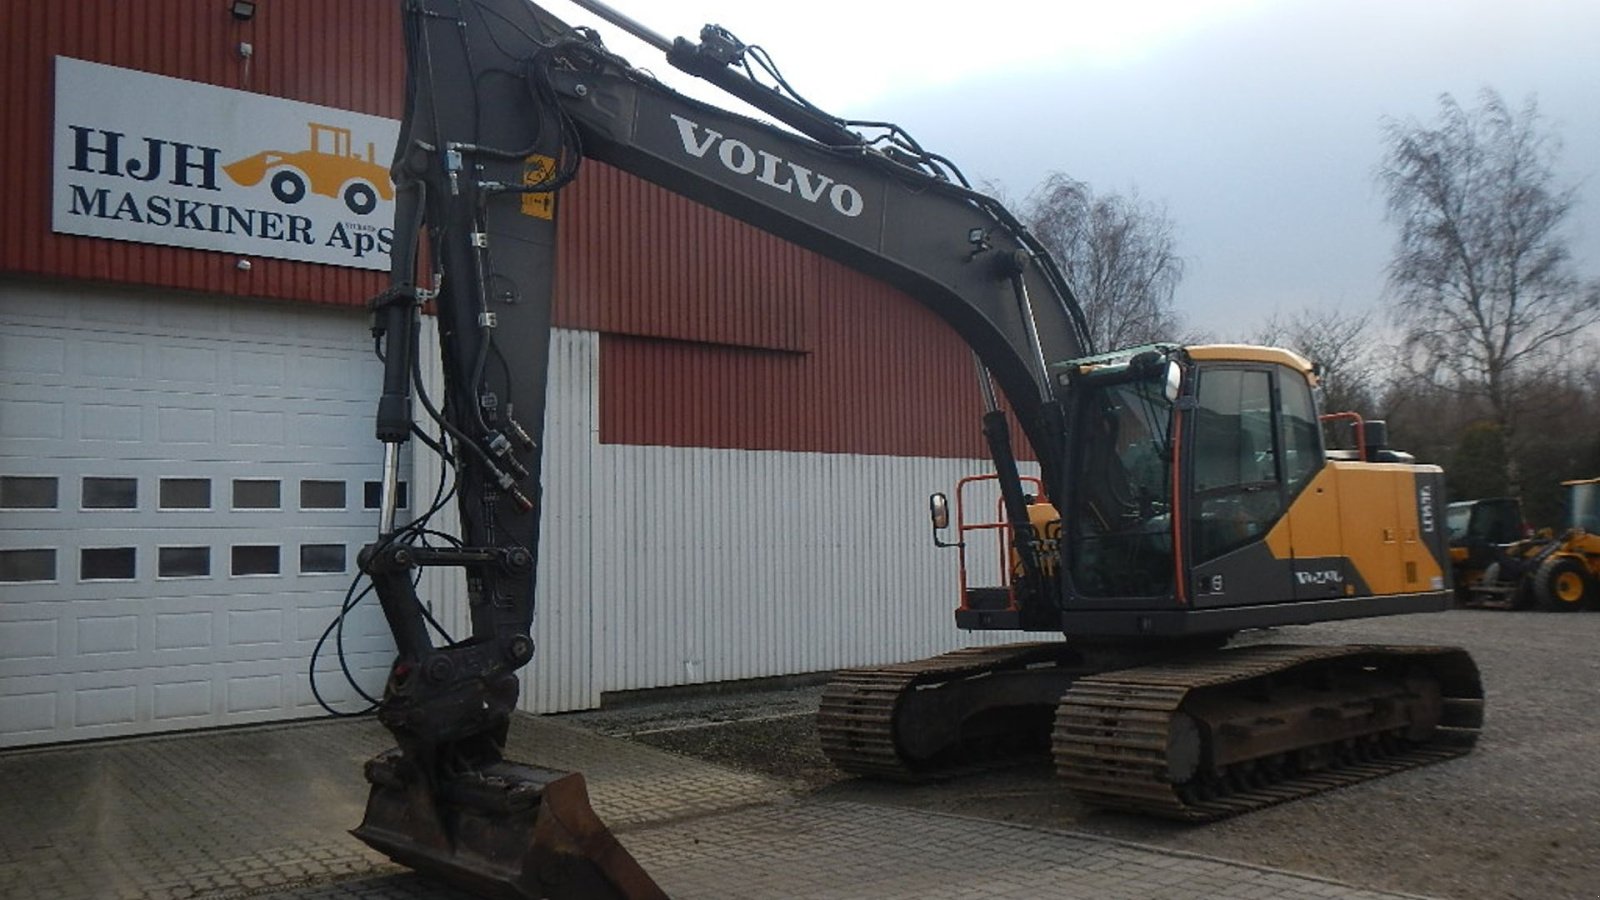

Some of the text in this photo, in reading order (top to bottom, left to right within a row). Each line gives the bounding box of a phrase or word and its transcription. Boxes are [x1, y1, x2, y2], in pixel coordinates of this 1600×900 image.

[68, 125, 221, 191] HJH
[670, 113, 863, 217] VOLVO
[68, 184, 394, 258] MASKINER ApS
